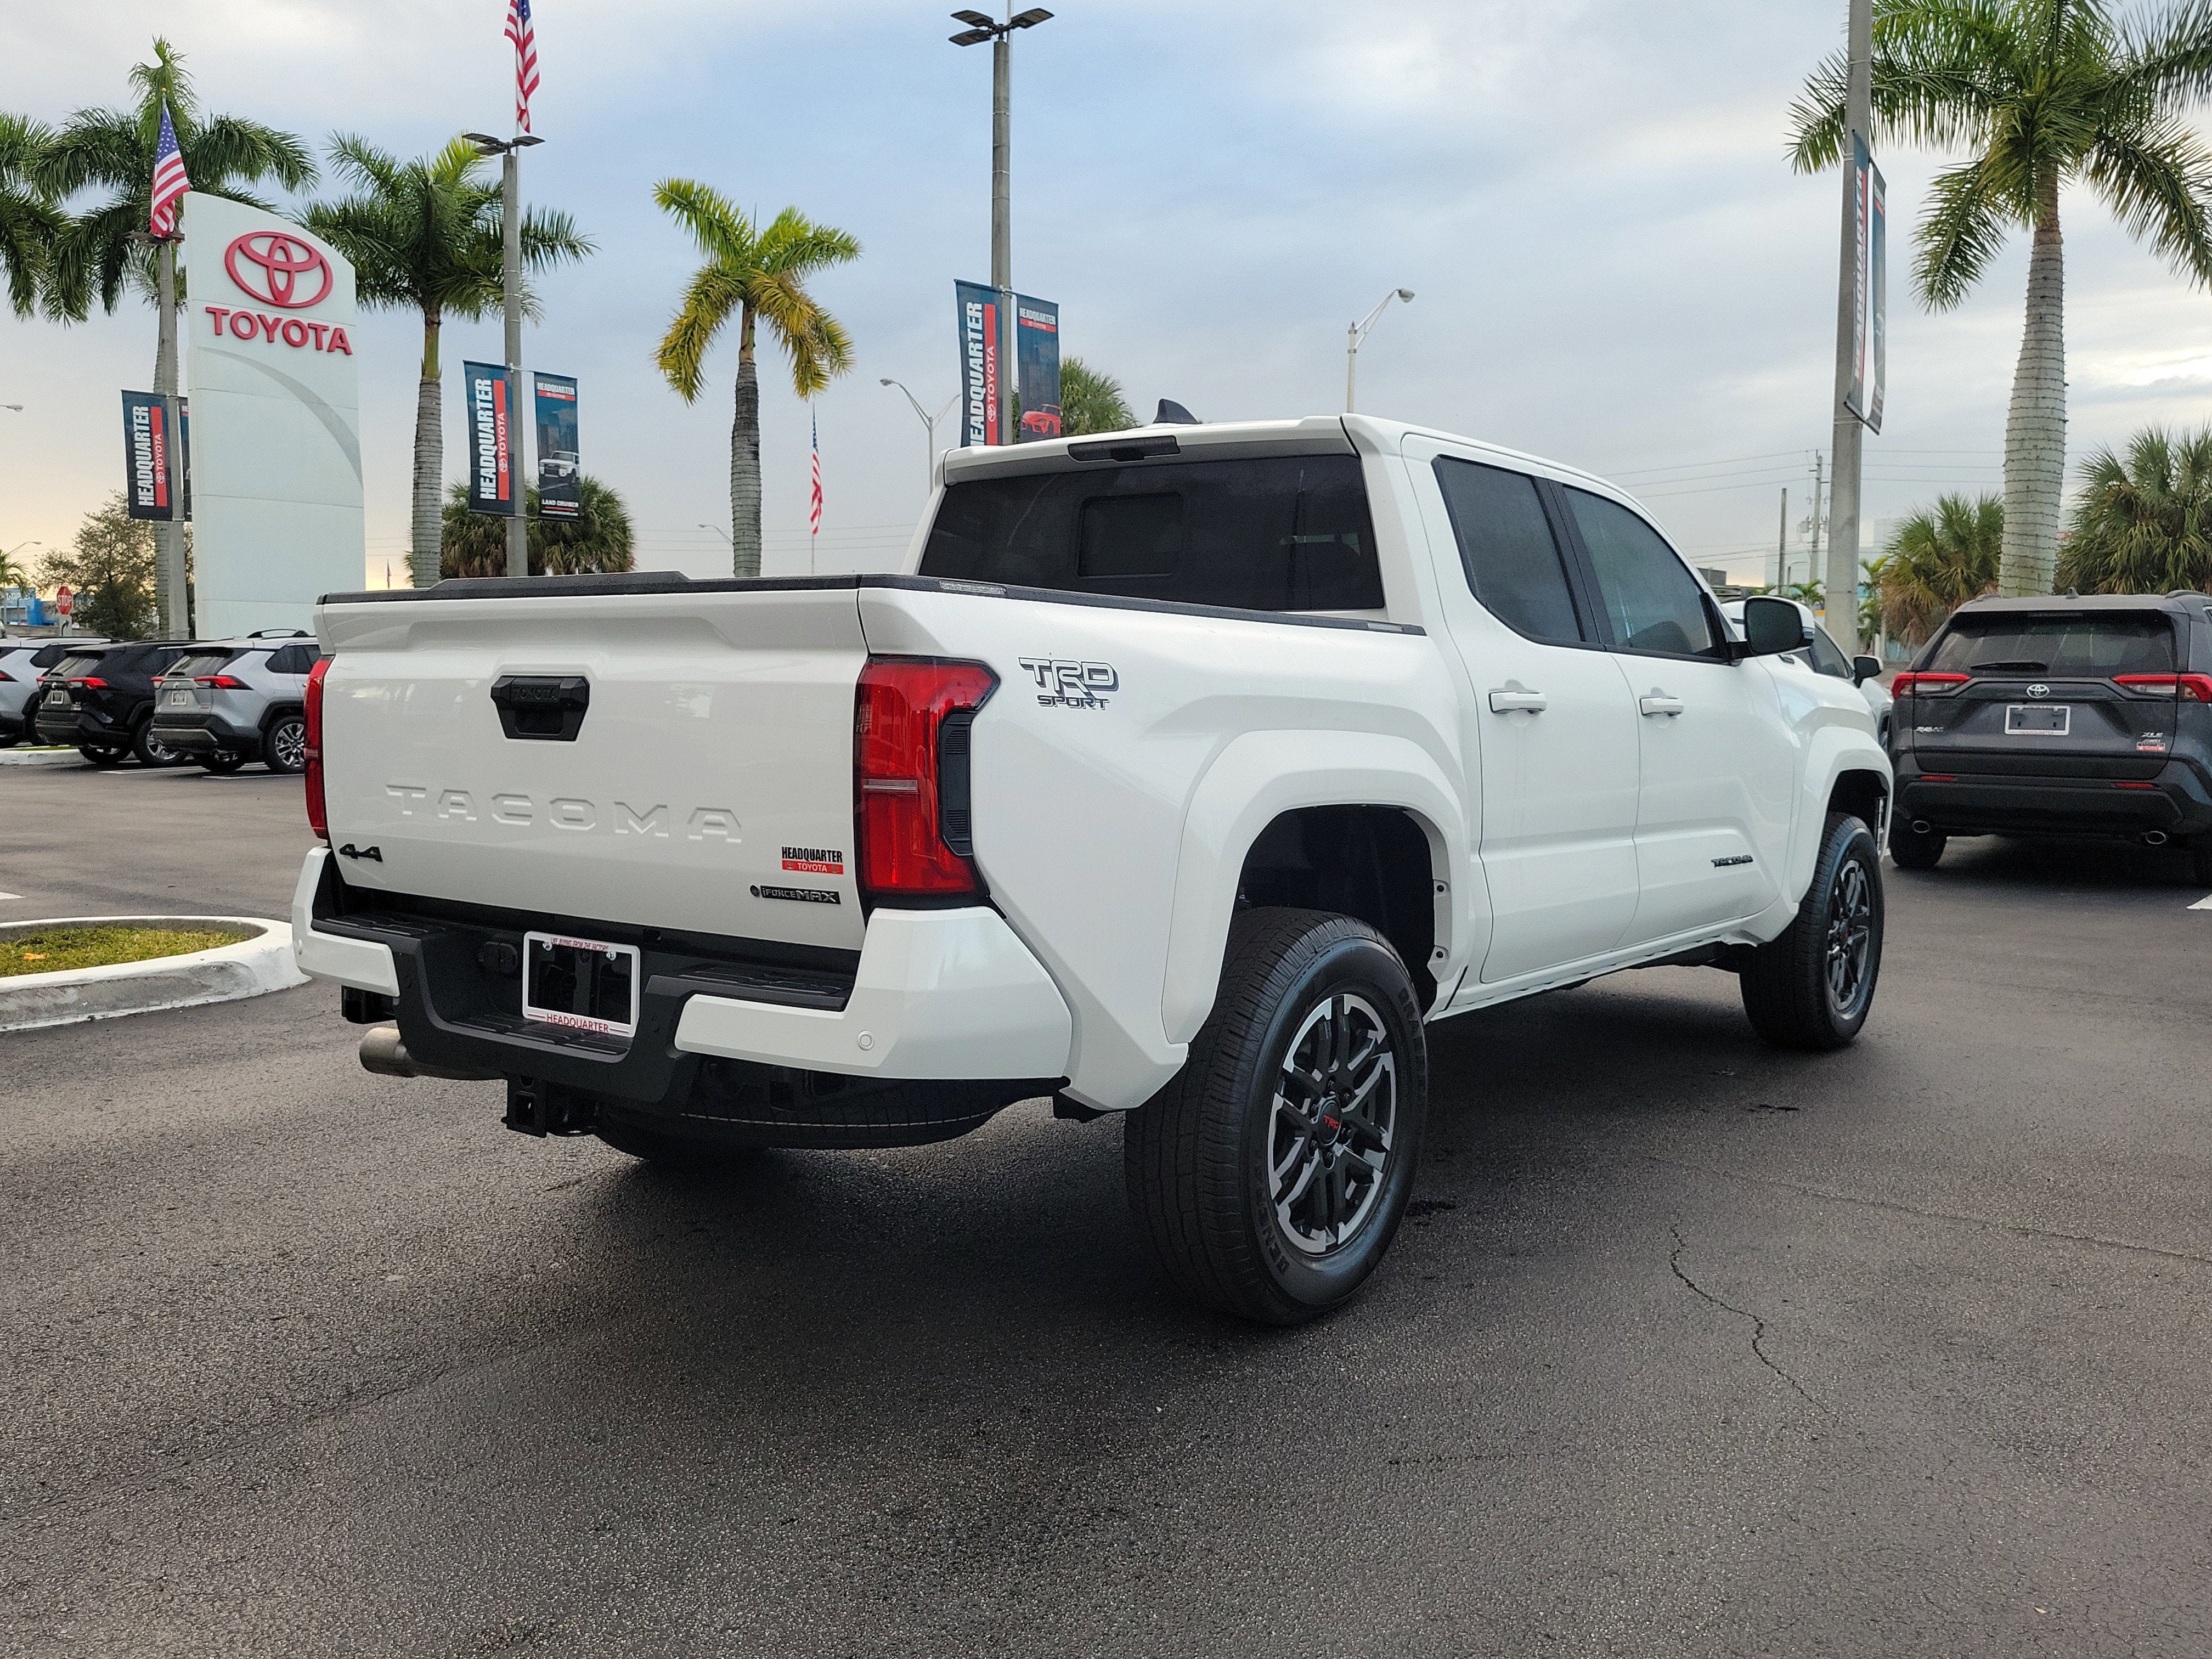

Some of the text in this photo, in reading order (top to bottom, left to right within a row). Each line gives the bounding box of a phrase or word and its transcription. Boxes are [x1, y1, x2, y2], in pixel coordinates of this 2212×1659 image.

[205, 307, 353, 356] TOYOTA
[154, 433, 163, 470] TOYOTA
[475, 379, 498, 500] HEADQUARTER
[497, 413, 506, 457] TOYOTA
[133, 406, 155, 506] HEADQUARTER
[58, 595, 72, 607] STOP
[514, 686, 557, 700] TOYOTA
[1018, 657, 1119, 699] TRD
[1037, 695, 1110, 710] SPORT
[386, 784, 742, 843] TACOMA
[782, 847, 843, 863] HEADQUARTER
[798, 862, 827, 872] TOYOTA
[547, 1013, 609, 1032] HEADQUARTER
